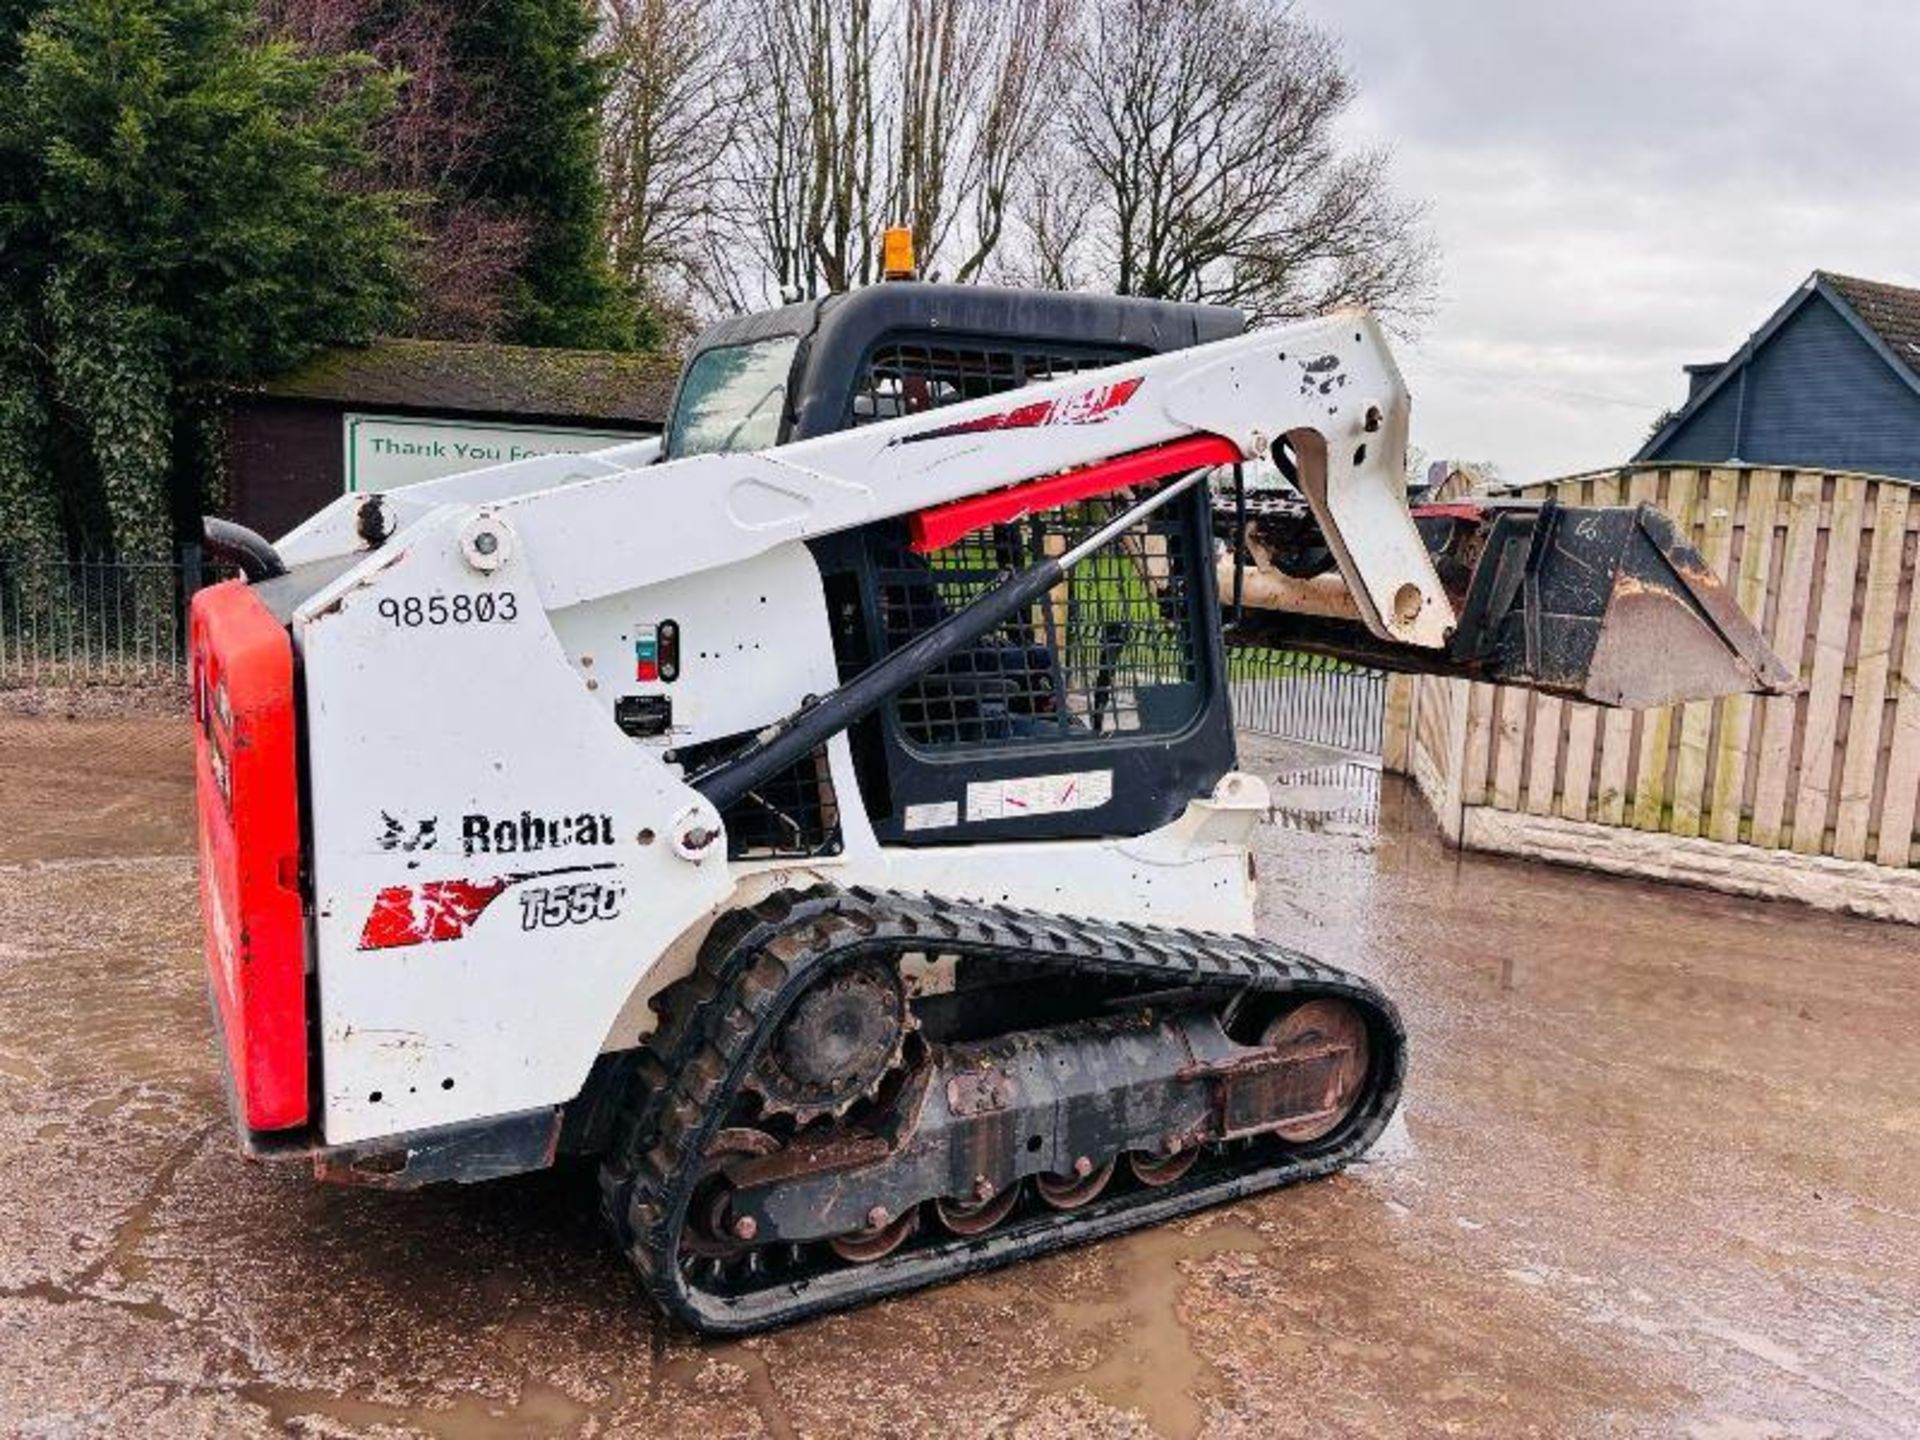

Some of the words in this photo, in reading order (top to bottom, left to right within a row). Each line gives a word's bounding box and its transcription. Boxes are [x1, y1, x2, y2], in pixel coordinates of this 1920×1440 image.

[370, 438, 446, 458] Thank
[453, 443, 501, 460] You
[378, 592, 518, 627] 985803
[462, 811, 616, 857] Bobcat
[519, 881, 626, 931] T550
